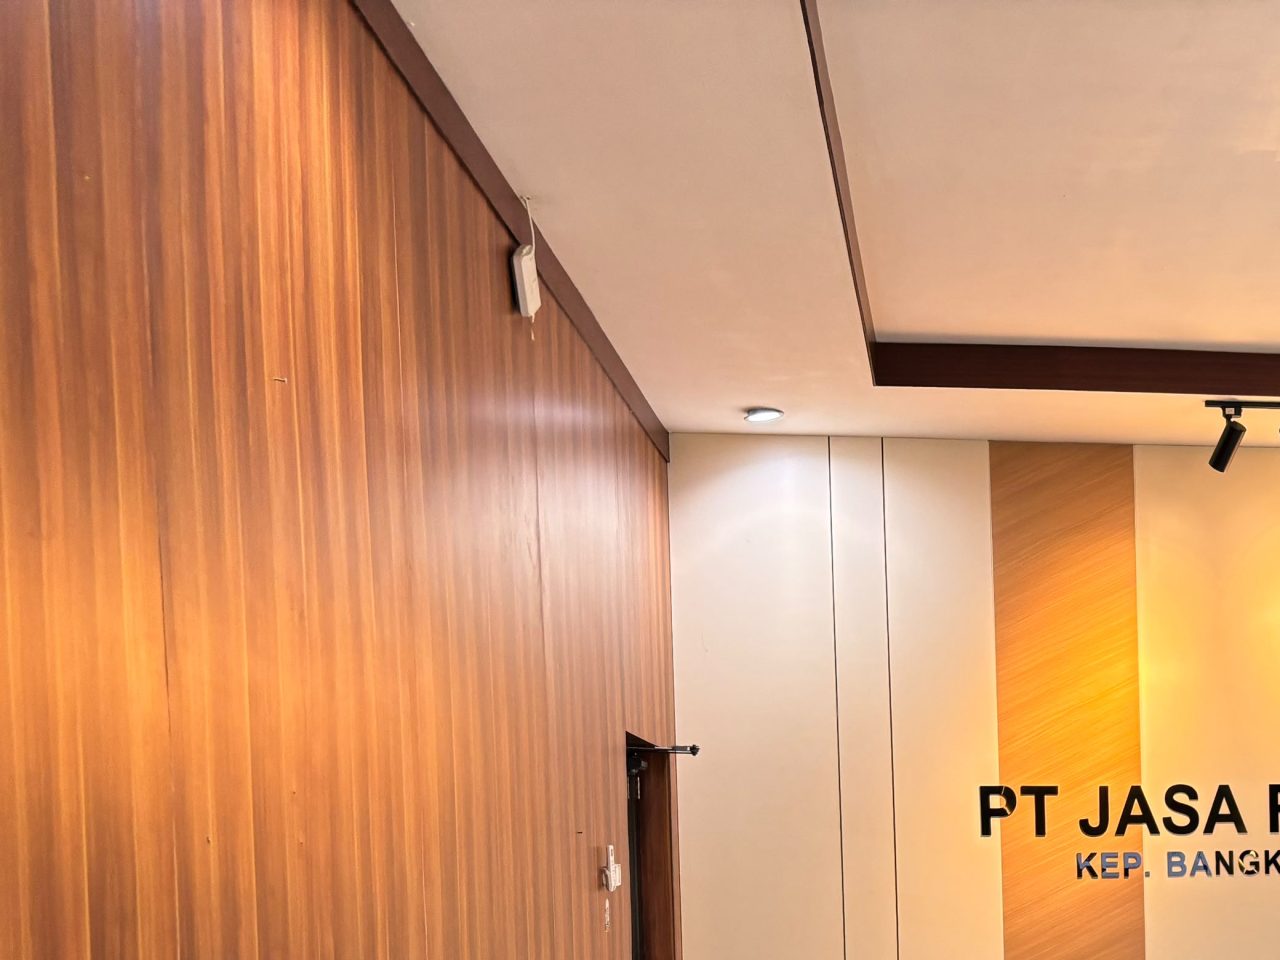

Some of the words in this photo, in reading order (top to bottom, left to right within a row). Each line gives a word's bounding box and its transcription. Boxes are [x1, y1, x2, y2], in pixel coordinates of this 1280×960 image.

[978, 785, 1059, 838] PT
[1078, 783, 1248, 837] JASA
[1075, 851, 1151, 880] KEP.
